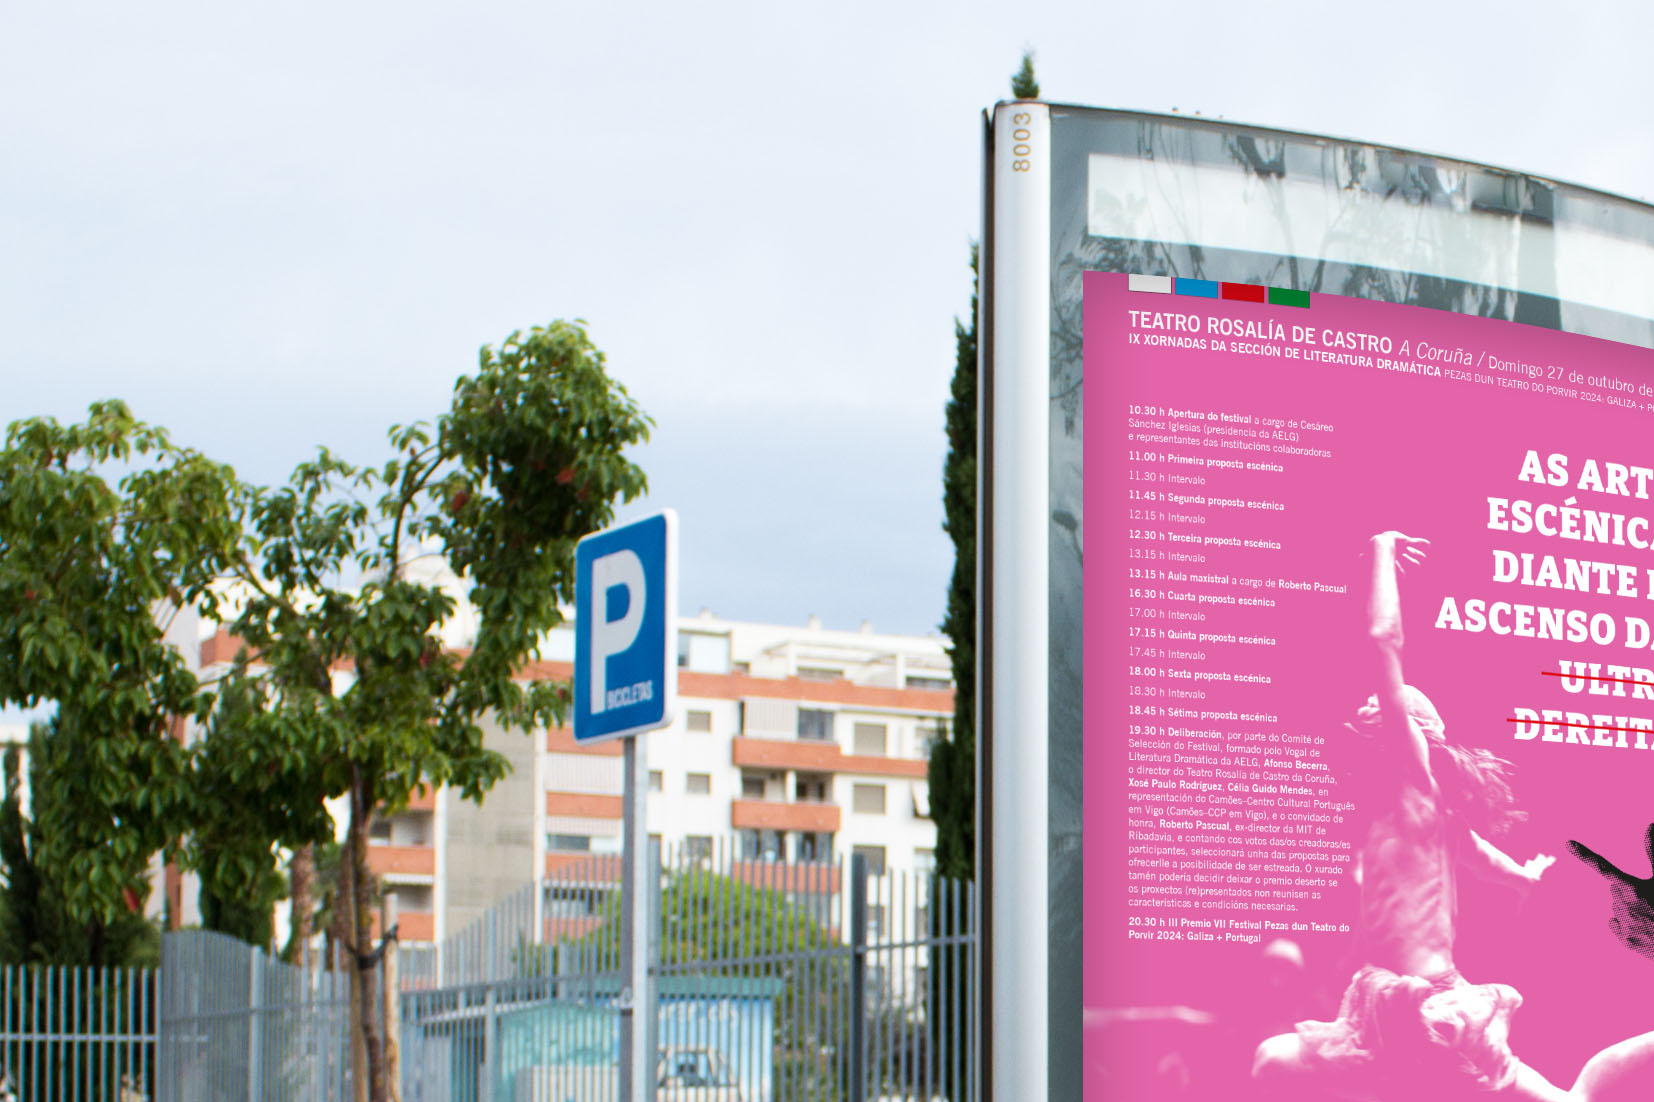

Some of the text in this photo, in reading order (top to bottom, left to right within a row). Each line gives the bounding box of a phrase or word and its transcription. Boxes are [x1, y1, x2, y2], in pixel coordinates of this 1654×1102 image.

[1013, 112, 1031, 172] 8003
[1128, 310, 1200, 333] TEATRO
[1208, 317, 1286, 341] ROSALÍA
[1292, 325, 1316, 345] DE
[1322, 329, 1392, 354] CASTRO
[1398, 339, 1410, 357] A
[1416, 342, 1473, 366] Coruña
[1476, 351, 1485, 367] /
[1488, 355, 1543, 379] Domingo
[1547, 365, 1564, 380] 27
[1568, 370, 1584, 384] de
[1588, 375, 1635, 394] outubro
[1638, 383, 1653, 397] de
[1129, 333, 1140, 344] IX
[1143, 334, 1207, 350] XORNADAS
[1211, 339, 1227, 352] DA
[1230, 342, 1281, 357] SECCIÓN
[1285, 347, 1300, 359] DE
[1304, 349, 1373, 368] LITERATURA
[1377, 358, 1441, 377] DRAMÁTICA
[1444, 369, 1472, 382] PEZAS
[1474, 373, 1494, 385] DUN
[1496, 377, 1530, 391] TEATRO
[1532, 382, 1544, 393] DO
[1546, 384, 1578, 399] PORVIR
[1606, 395, 1637, 408] GALIZA
[1129, 404, 1334, 432] 10.30 h Apertura do festival a cargo de Cesáreo
[1128, 418, 1299, 442] Sánchez Iglesias (presidencia da AELG)
[1136, 434, 1200, 446] representantes
[1203, 437, 1218, 447] das
[1221, 438, 1271, 452] institucións
[1273, 444, 1332, 458] colaboradoras
[1129, 450, 1283, 472] 11.00 h Primeira proposta escénica
[1518, 450, 1569, 487] AS
[1129, 470, 1206, 485] 11.30 h Intervalo
[1129, 489, 1284, 511] 11.45 h Segunda proposta escénica
[1130, 509, 1206, 524] 12.15 h Intervalo
[1129, 529, 1281, 550] 12.30 h Terceira proposta escénica
[1129, 548, 1206, 563] 13.15 h Intervalo
[1129, 568, 1347, 593] 13.15 h Aula maxistral a cargo de Roberto Pascual
[1493, 549, 1637, 598] DIANTE
[1129, 588, 1275, 607] 16.30 h Cuarta proposta escénica
[1129, 607, 1206, 621] 17.00 h Intervalo
[1434, 596, 1615, 645] ASCENSO
[592, 549, 646, 714] P
[1129, 627, 1276, 646] 17.15 h Quinta proposta escénica
[1129, 646, 1206, 660] 17.45 h Intervalo
[1129, 666, 1271, 684] 18.00 h Sexta proposta escénica
[606, 680, 653, 710] BICICLETAS
[1130, 685, 1206, 699] 18.30 h Intervalo
[1129, 705, 1278, 722] 18.45 h Sétima proposta escénica
[1128, 916, 1350, 932] 20.30 h III Premio VII Festival Pezas dun Teatro do
[1128, 930, 1154, 940] Porvir
[1156, 930, 1184, 940] 2024:
[1187, 931, 1214, 941] Galiza
[1225, 932, 1261, 944] Portugal
